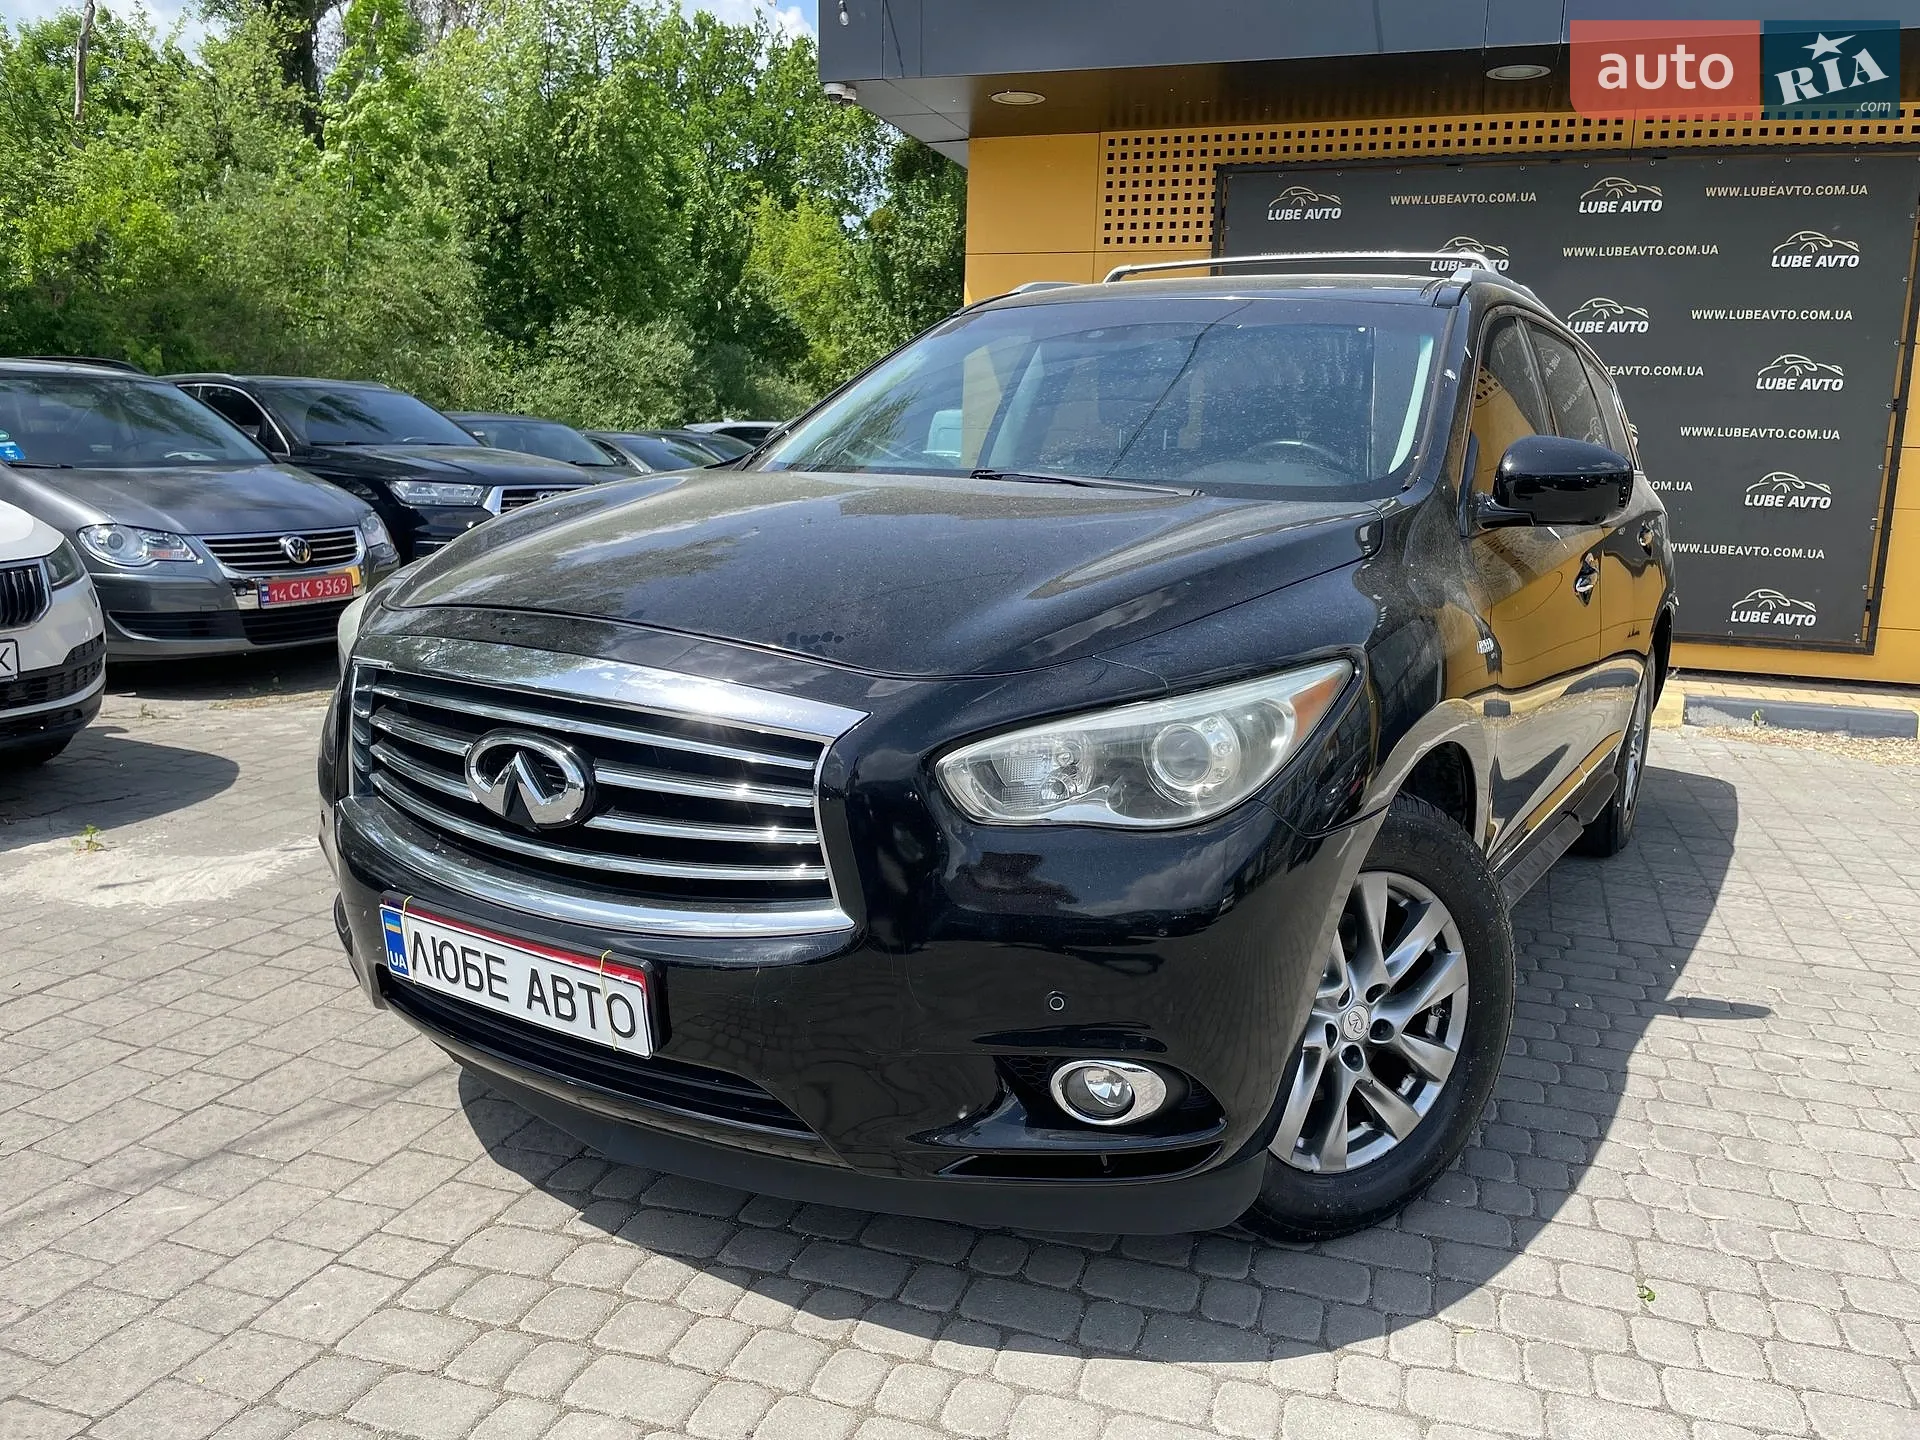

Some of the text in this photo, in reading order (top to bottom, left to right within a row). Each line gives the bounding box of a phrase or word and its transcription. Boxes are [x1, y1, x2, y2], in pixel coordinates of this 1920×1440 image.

[1390, 192, 1537, 205] WWW.LUBEAVTO.COM.UA
[1705, 185, 1868, 198] WWW.LUBEAVTO.COM.UA
[1579, 199, 1662, 214] LUBE AVTO
[1267, 207, 1342, 221] LUBE AVTO
[1563, 245, 1719, 258] WWW.LUBEAVTO.COM.UA
[1771, 254, 1860, 268] LUBE AVTO
[1691, 307, 1853, 321] WWW.LUBEAVTO.COM.UA
[1606, 320, 1649, 333] AVTO
[1606, 365, 1704, 377] EAVTO.COM.UA
[1756, 377, 1844, 392] LUBE AVTO
[1680, 425, 1840, 441] WWW.LUBEAVTO.COM.UA
[1744, 494, 1832, 509] LUBE AVTO
[271, 577, 348, 601] 14 CK 9369
[1730, 610, 1817, 626] LUBE AVTO
[389, 950, 408, 970] UA
[411, 930, 636, 1039] ЛЮБЕ АВТО
